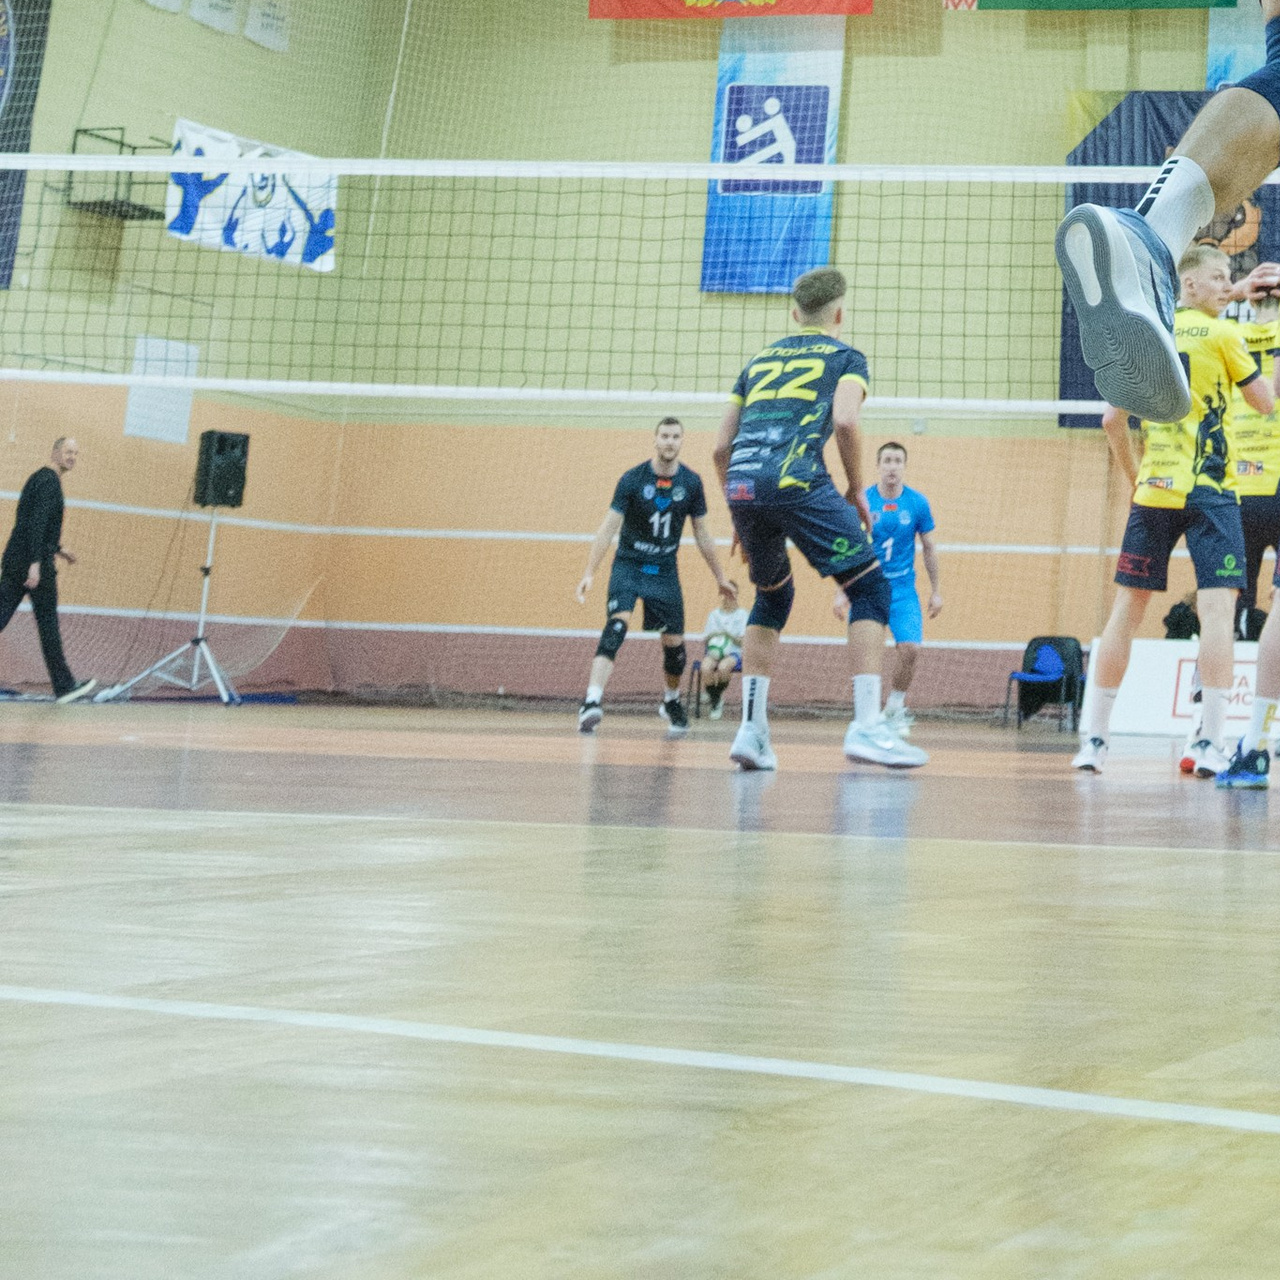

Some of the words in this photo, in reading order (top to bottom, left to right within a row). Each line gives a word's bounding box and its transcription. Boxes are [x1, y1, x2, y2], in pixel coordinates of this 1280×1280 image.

[745, 358, 826, 408] 22
[648, 511, 673, 539] 11
[881, 537, 894, 562] 1
